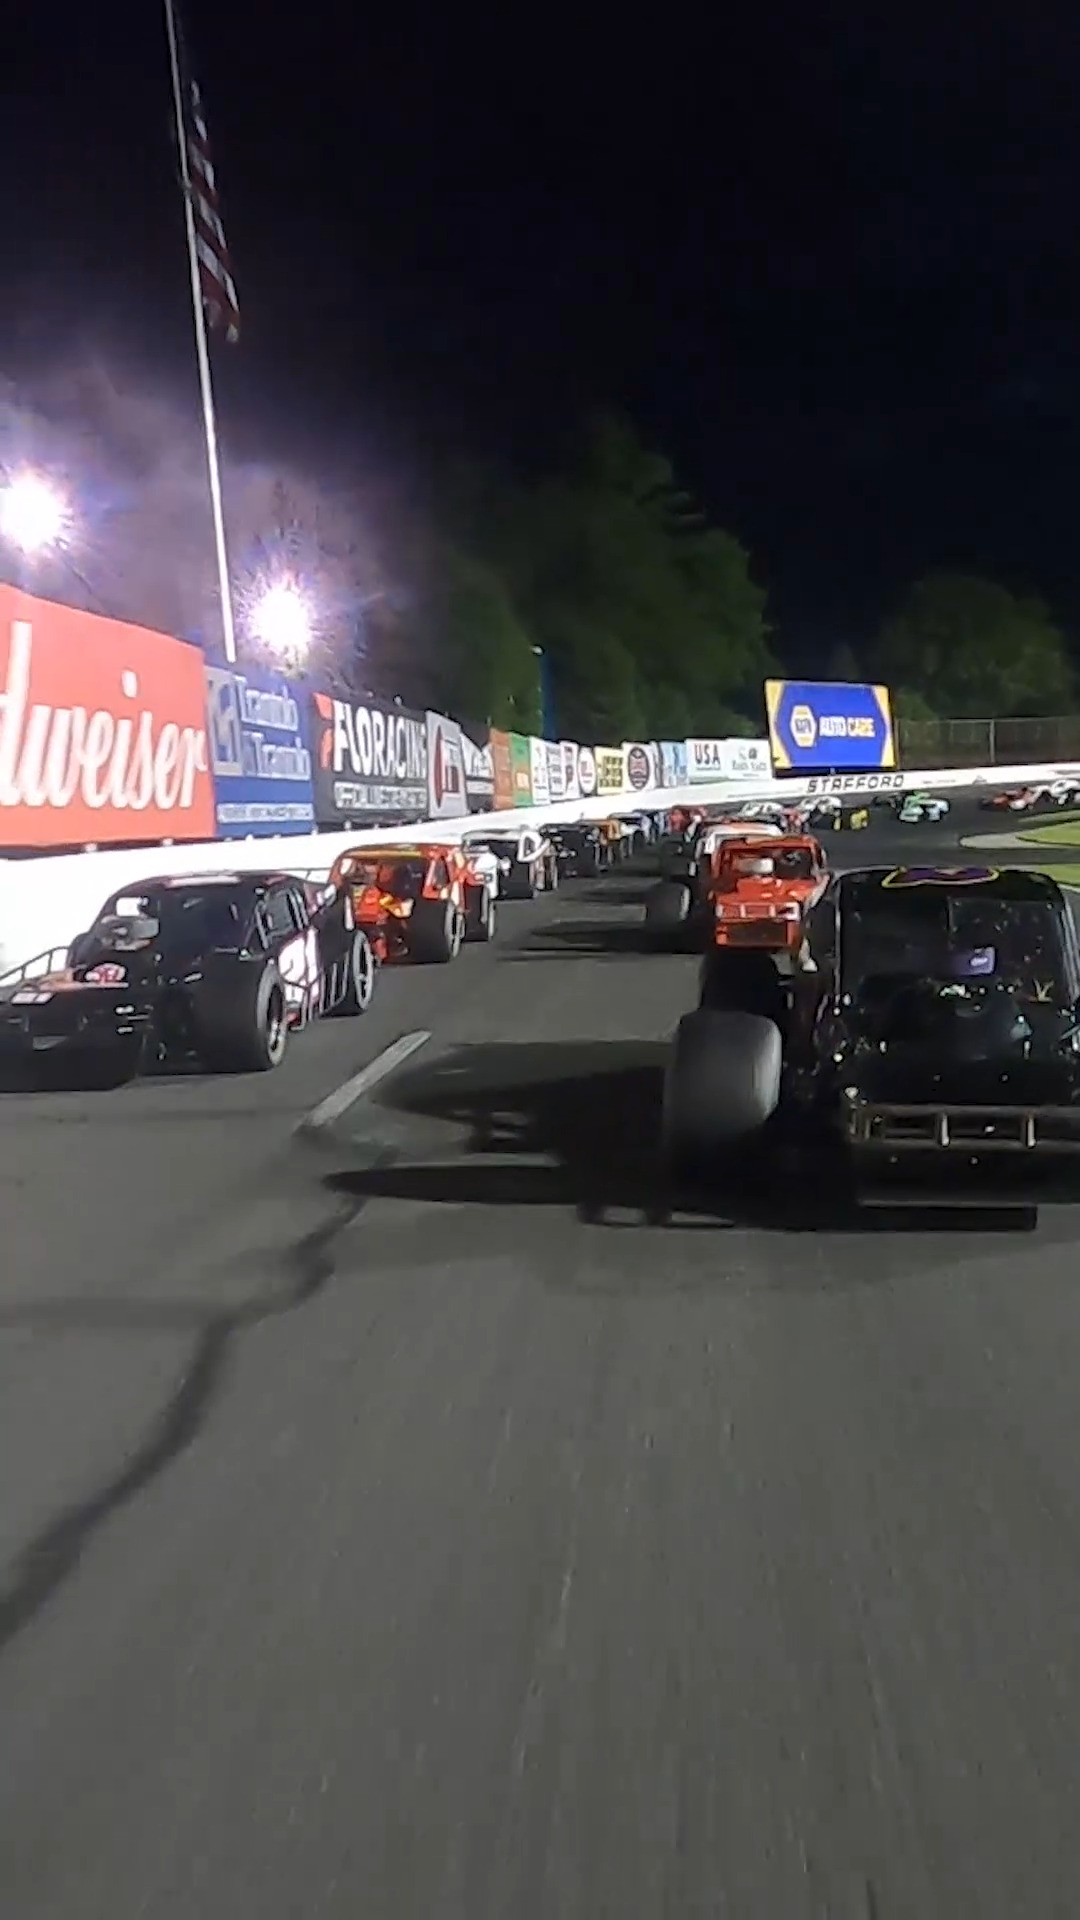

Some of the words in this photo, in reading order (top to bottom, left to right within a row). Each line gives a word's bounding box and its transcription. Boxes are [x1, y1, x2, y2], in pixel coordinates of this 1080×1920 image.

[819, 715, 846, 737] AUTO
[847, 716, 875, 737] CARE
[694, 743, 721, 765] USA
[807, 774, 905, 794] STAFFORD
